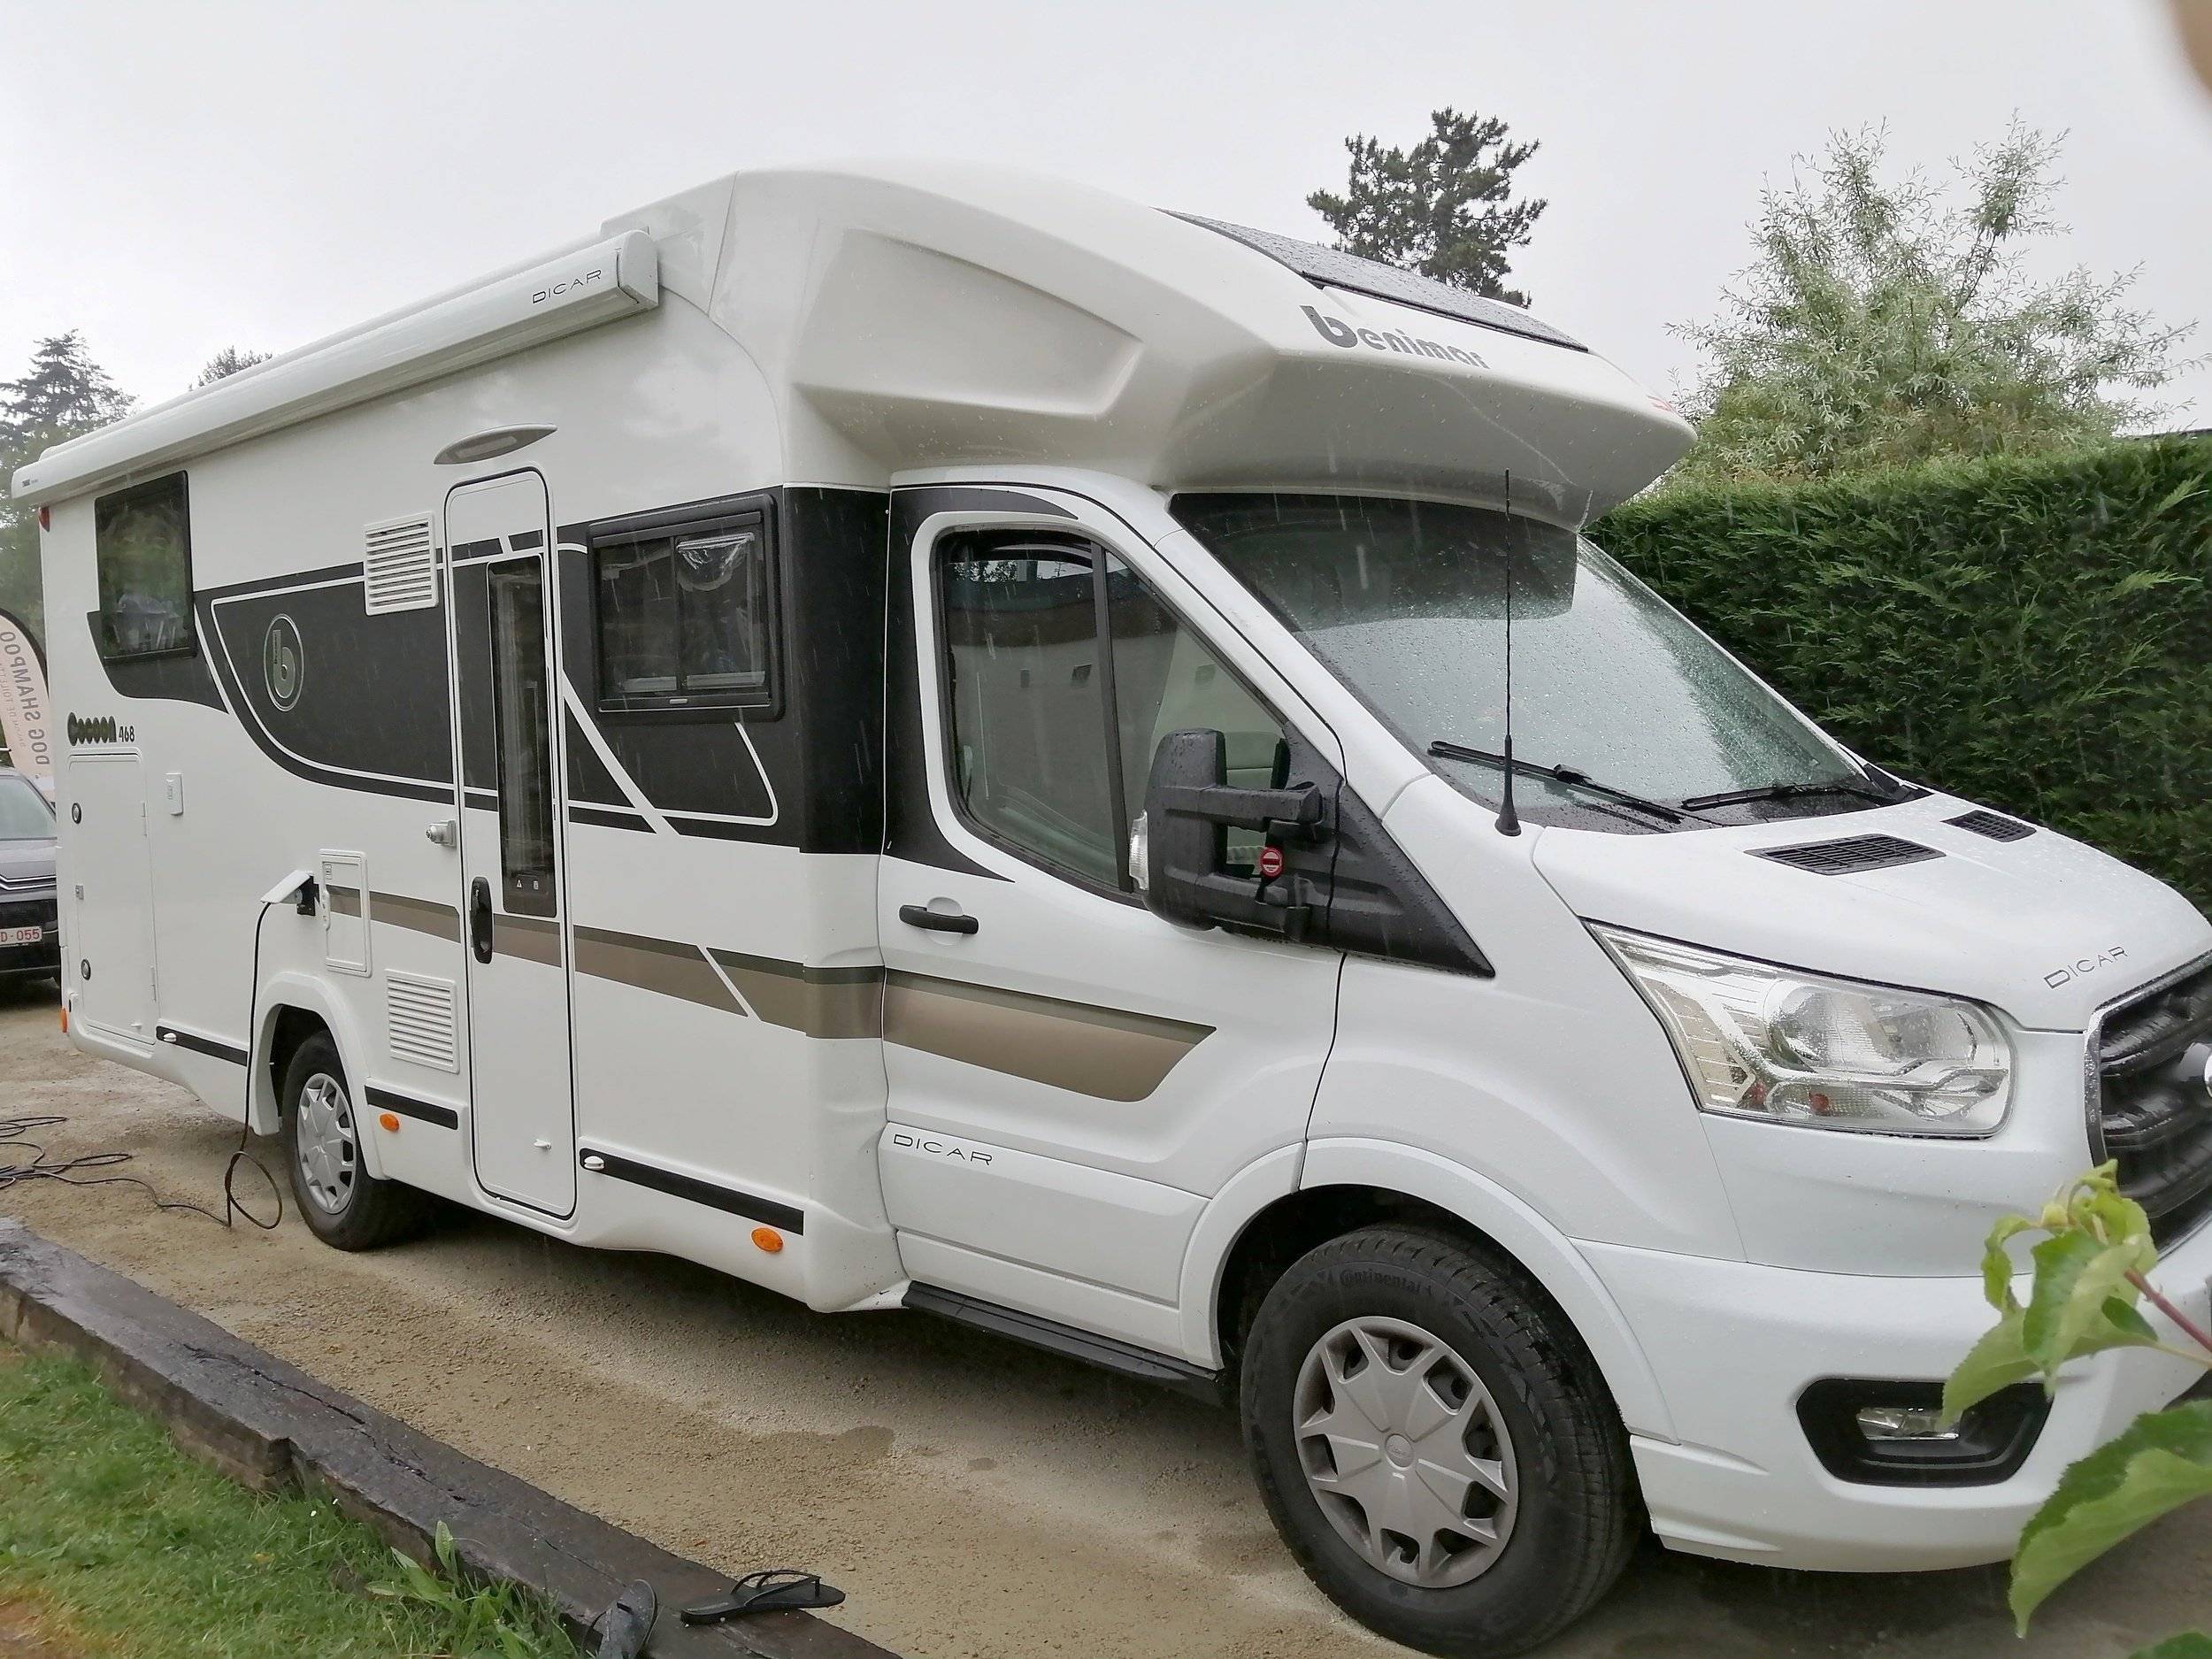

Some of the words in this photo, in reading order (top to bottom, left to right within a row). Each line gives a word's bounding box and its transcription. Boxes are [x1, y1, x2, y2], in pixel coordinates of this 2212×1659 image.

[532, 269, 602, 303] DICAR
[1300, 305, 1491, 369] benimar
[119, 726, 135, 743] 468
[2043, 946, 2128, 989] DICAR
[893, 1133, 993, 1166] DICAR
